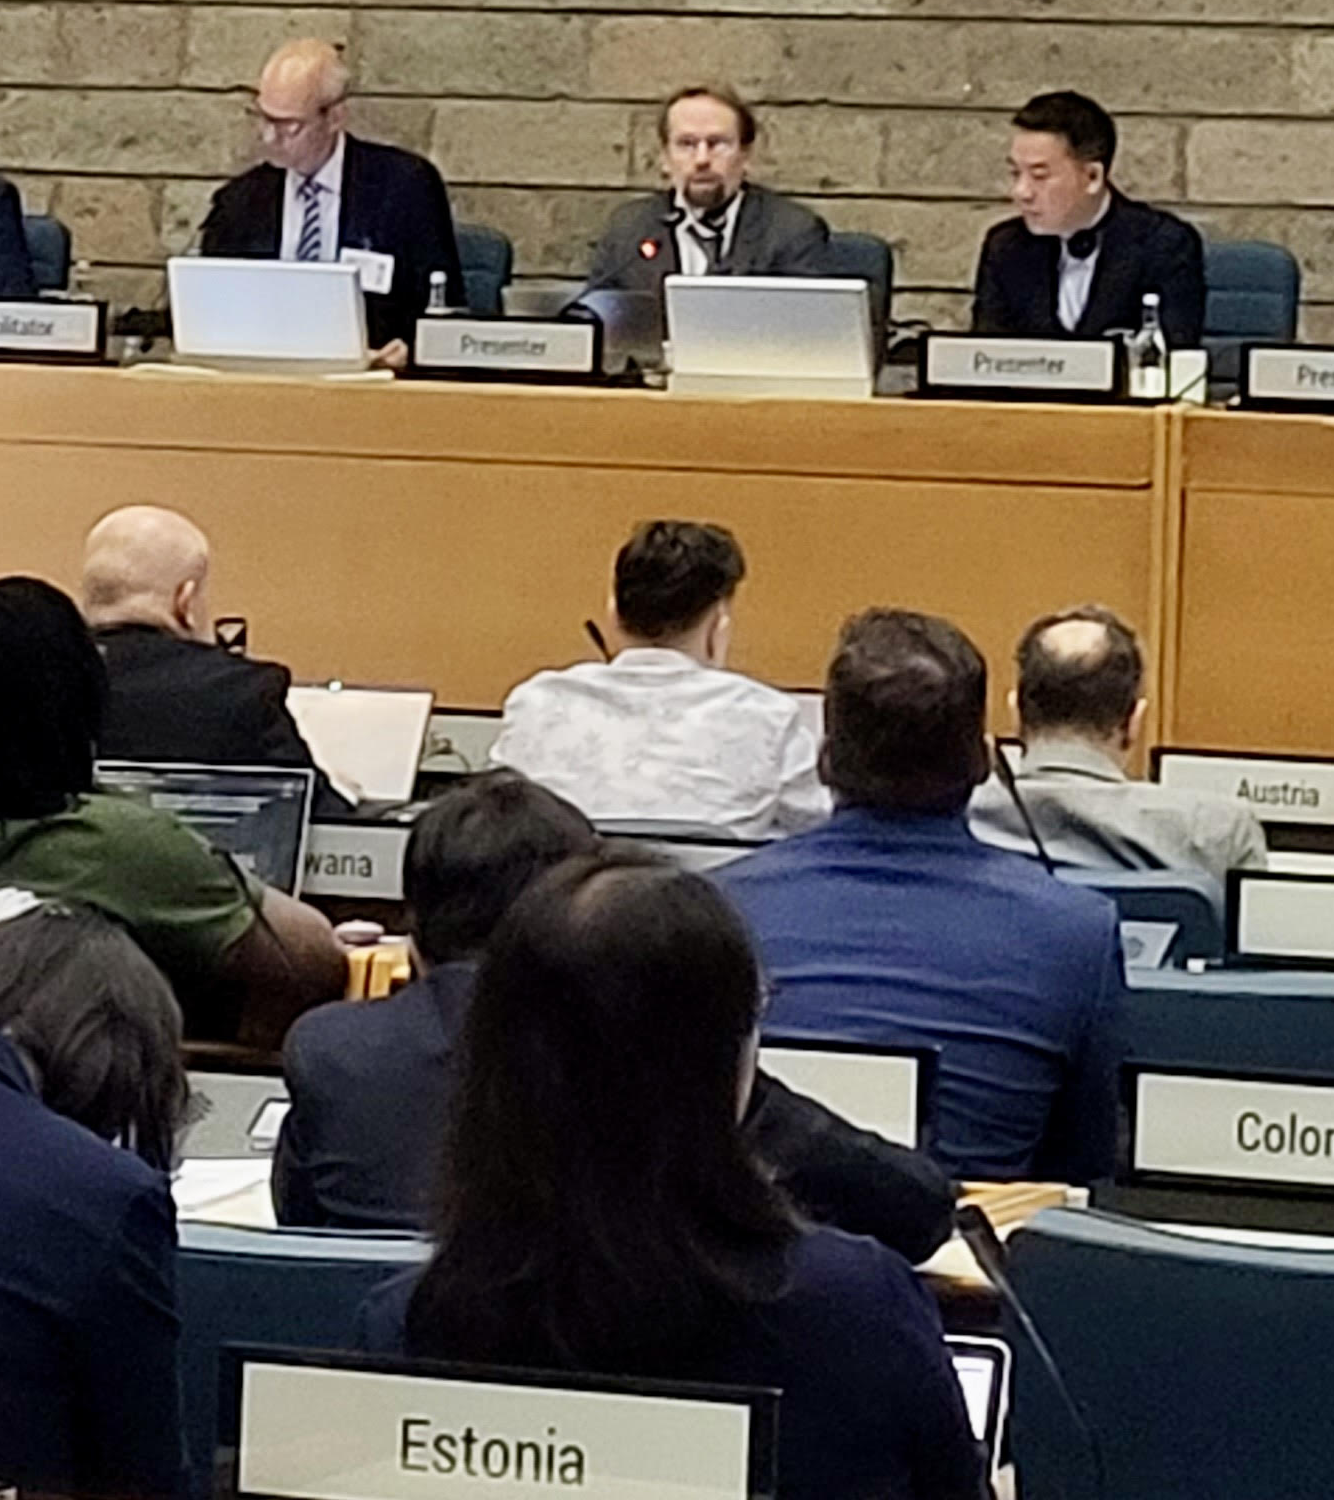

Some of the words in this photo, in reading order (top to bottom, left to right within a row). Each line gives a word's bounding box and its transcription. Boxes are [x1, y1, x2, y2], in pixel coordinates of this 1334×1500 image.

[460, 333, 548, 356] Presenter
[974, 351, 1066, 374] Presenter
[1236, 779, 1320, 808] Austria
[401, 1418, 585, 1486] Estonia
